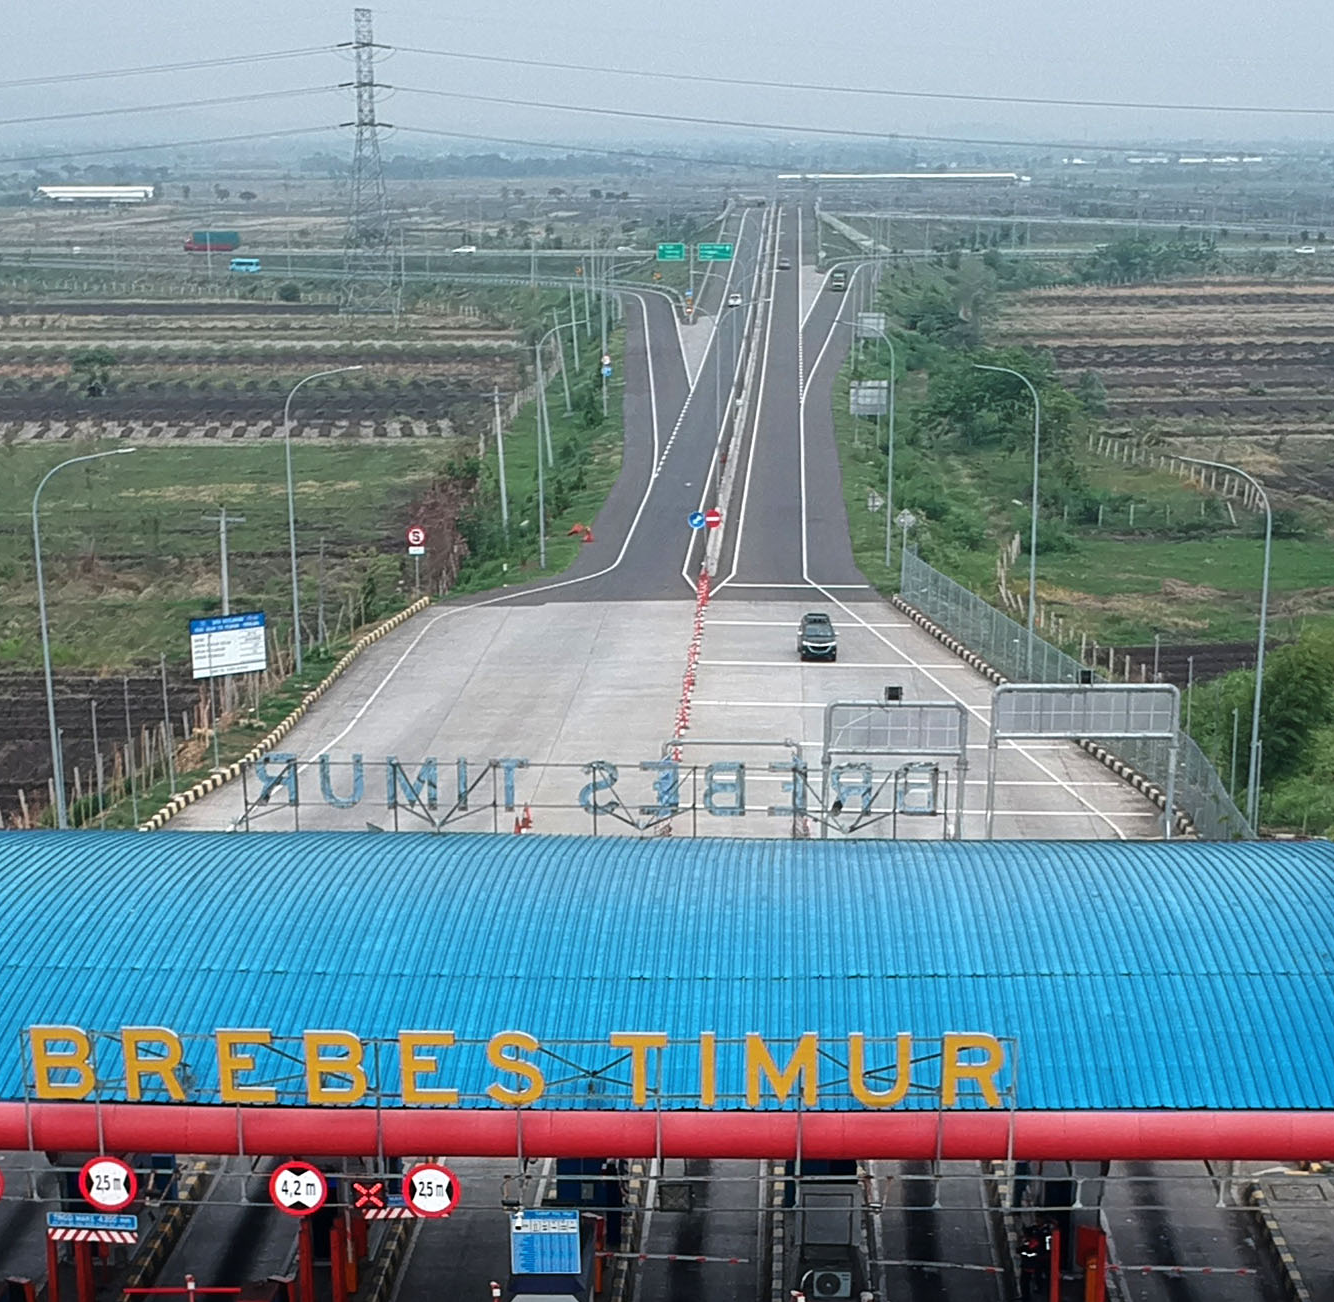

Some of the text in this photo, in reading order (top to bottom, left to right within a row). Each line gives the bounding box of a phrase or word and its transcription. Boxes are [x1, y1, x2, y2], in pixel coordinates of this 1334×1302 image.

[29, 1025, 1005, 1107] BREBES TIMUR
[113, 1178, 122, 1191] m
[281, 1180, 316, 1198] 4,2 m
[436, 1184, 444, 1197] m
